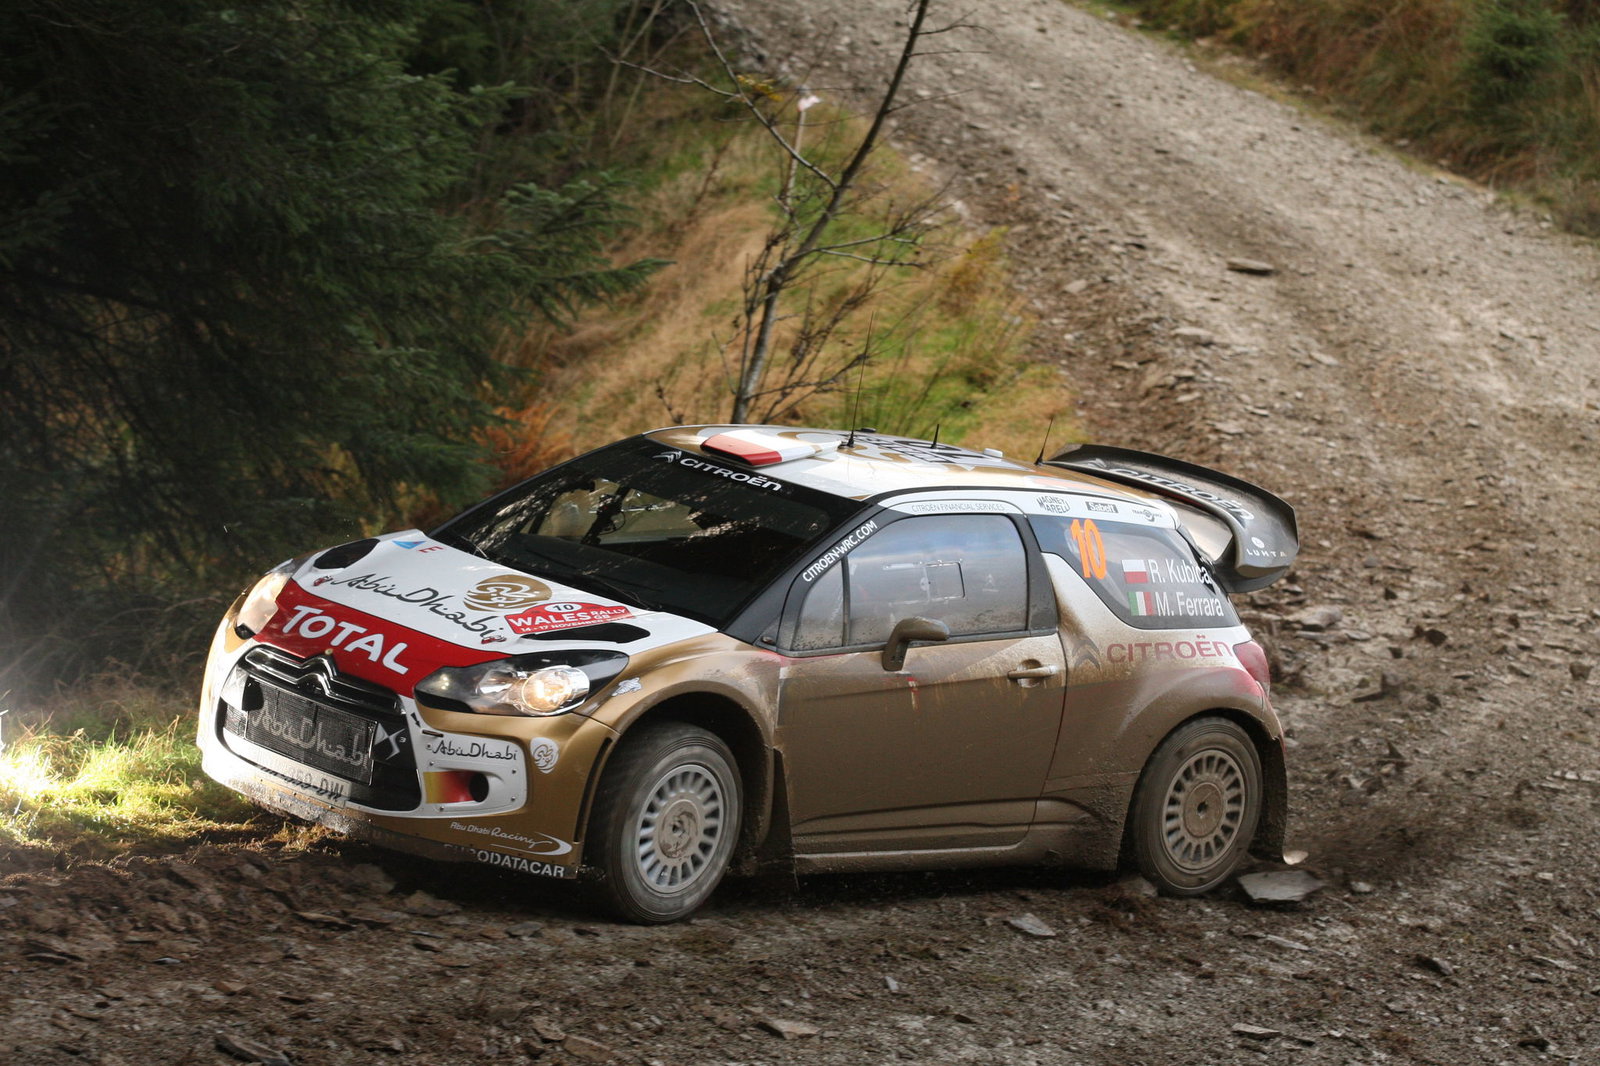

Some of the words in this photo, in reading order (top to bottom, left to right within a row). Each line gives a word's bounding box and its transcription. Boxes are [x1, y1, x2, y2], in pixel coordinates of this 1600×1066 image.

[802, 520, 878, 583] CITROEN-WRC.COM
[1069, 518, 1107, 580] 10
[1149, 559, 1166, 583] R.
[1168, 558, 1213, 584] Kubica
[509, 613, 591, 627] WALES
[590, 608, 626, 616] RALLY
[552, 603, 574, 611] 10
[1154, 598, 1175, 618] M.
[1179, 598, 1224, 618] Ferrara
[551, 618, 603, 629] NOVEMBER
[281, 604, 409, 675] TOTAL
[451, 822, 466, 831] Abu
[467, 824, 490, 834] Dhabi
[491, 827, 538, 848] Racing
[444, 843, 565, 878] ODATACAR
